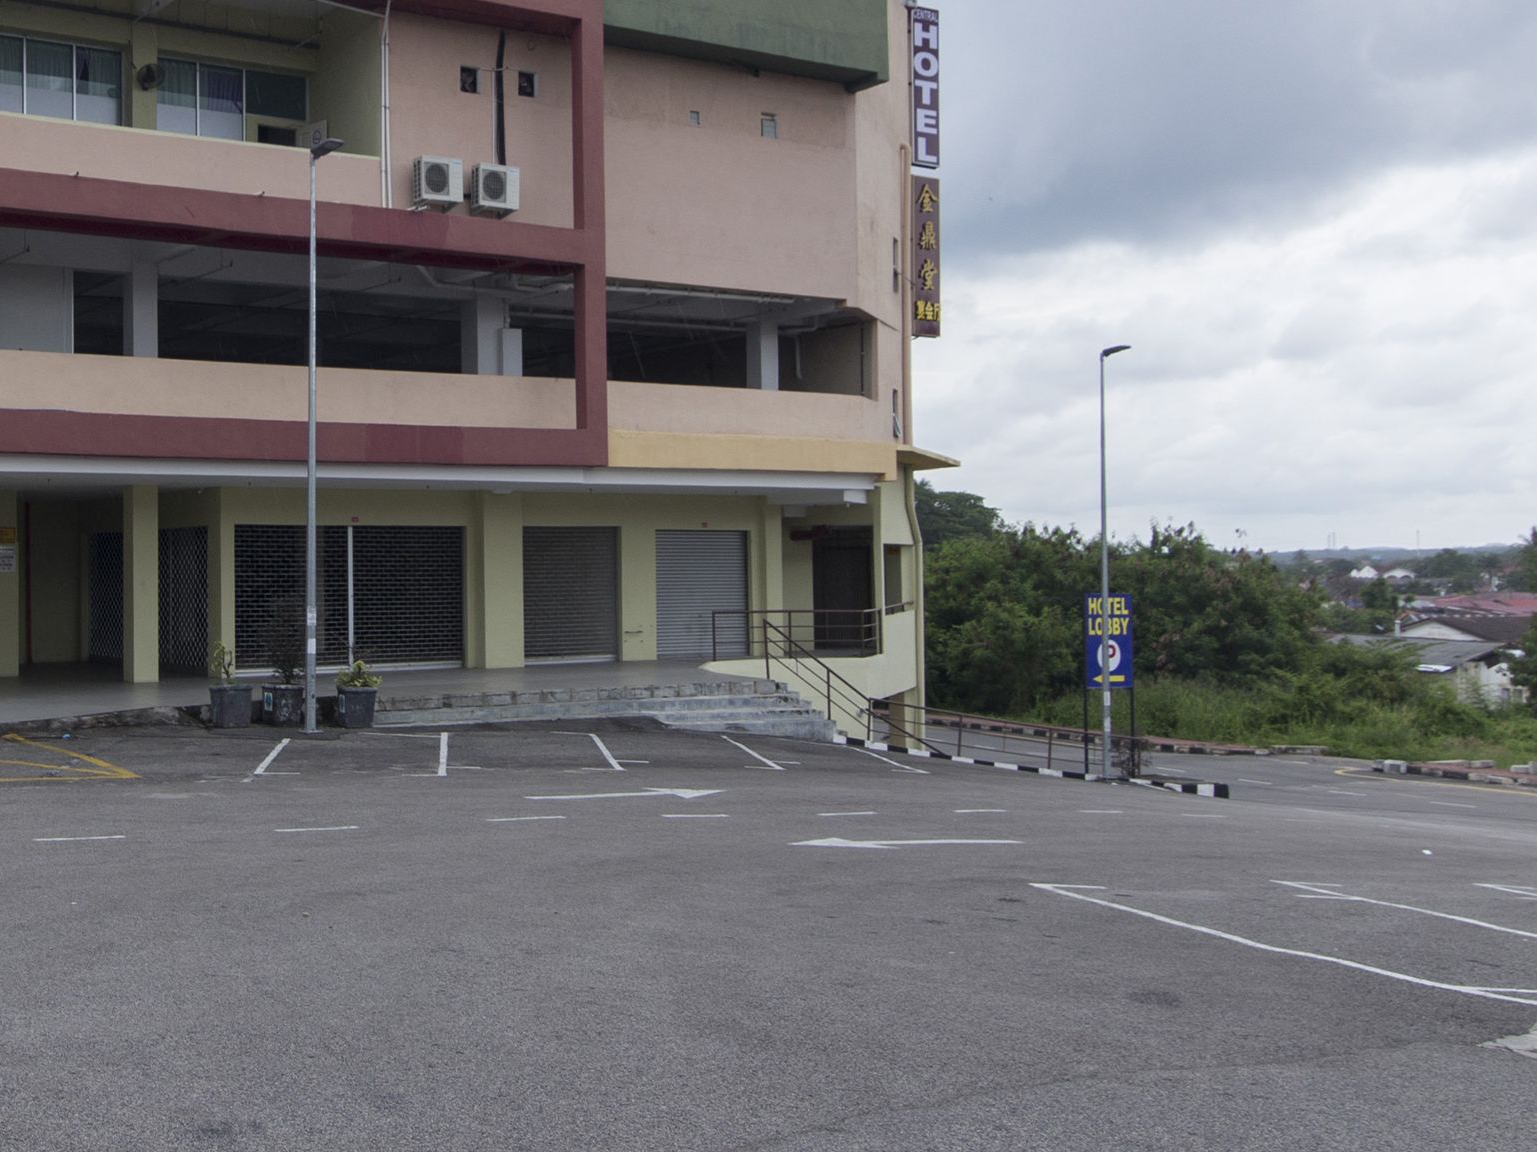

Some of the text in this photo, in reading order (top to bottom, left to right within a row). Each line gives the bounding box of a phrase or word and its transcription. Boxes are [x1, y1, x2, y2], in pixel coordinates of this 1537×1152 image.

[913, 22, 938, 163] HOTEL
[917, 184, 939, 290] 金鼎堂
